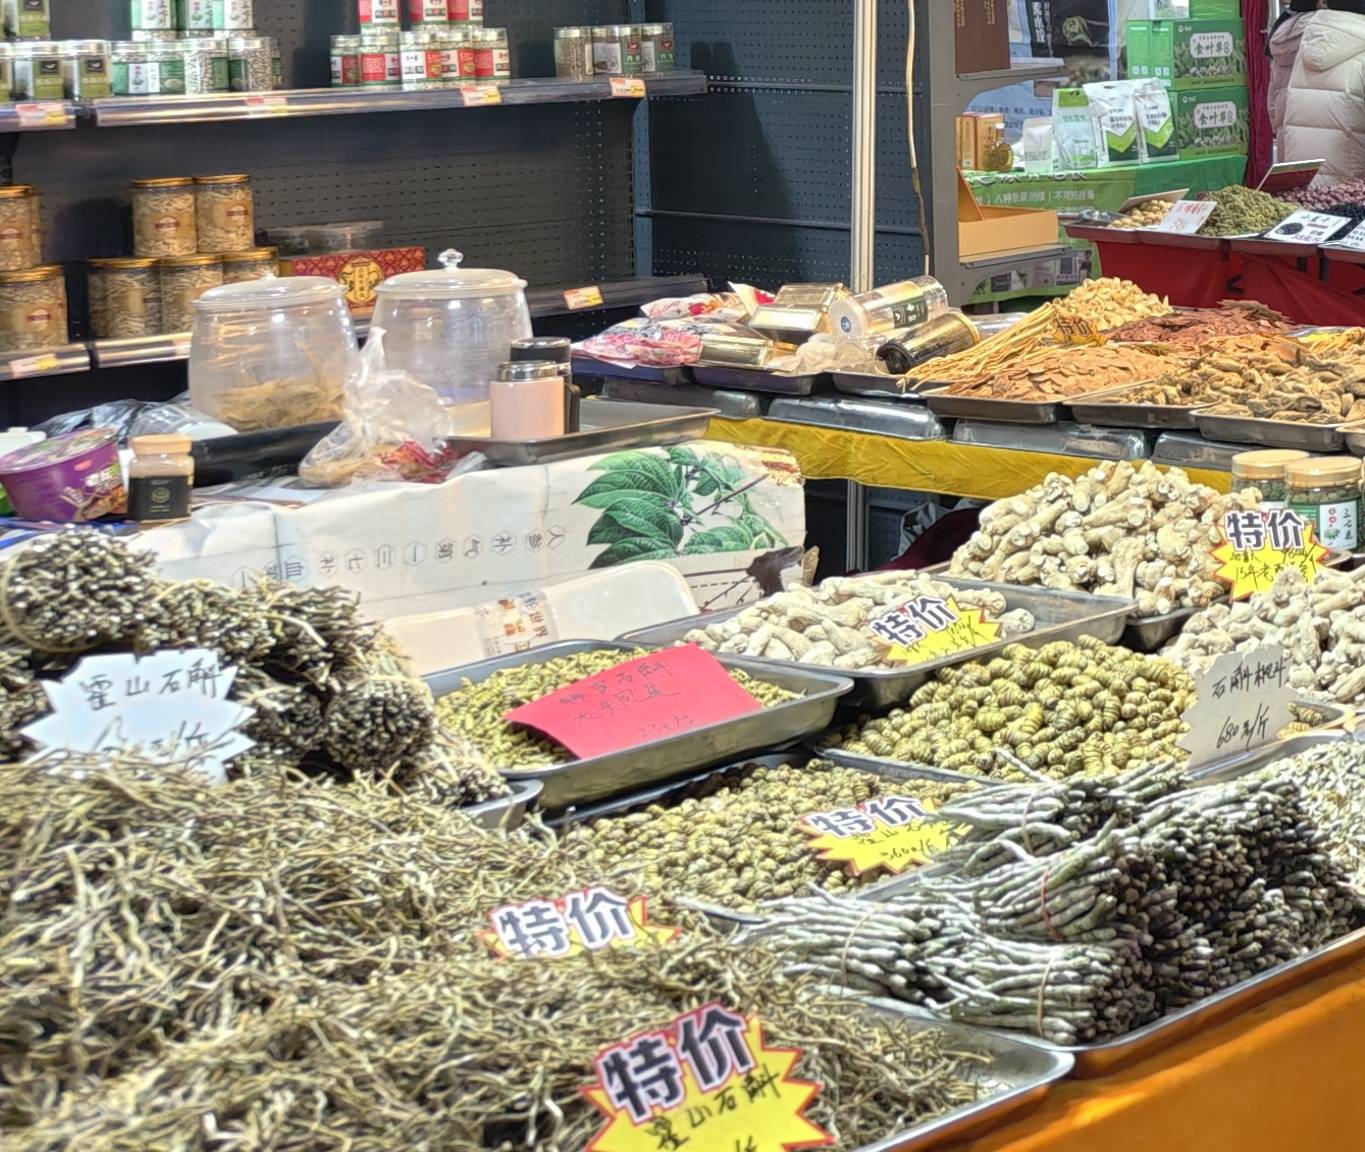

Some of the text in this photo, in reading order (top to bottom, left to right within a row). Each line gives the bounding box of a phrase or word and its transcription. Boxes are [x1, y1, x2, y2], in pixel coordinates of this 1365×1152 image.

[1226, 511, 1303, 549] 特价
[871, 598, 956, 646] 特价
[811, 797, 926, 837] 特价
[495, 889, 635, 957] 特价
[601, 1007, 752, 1119] 特价
